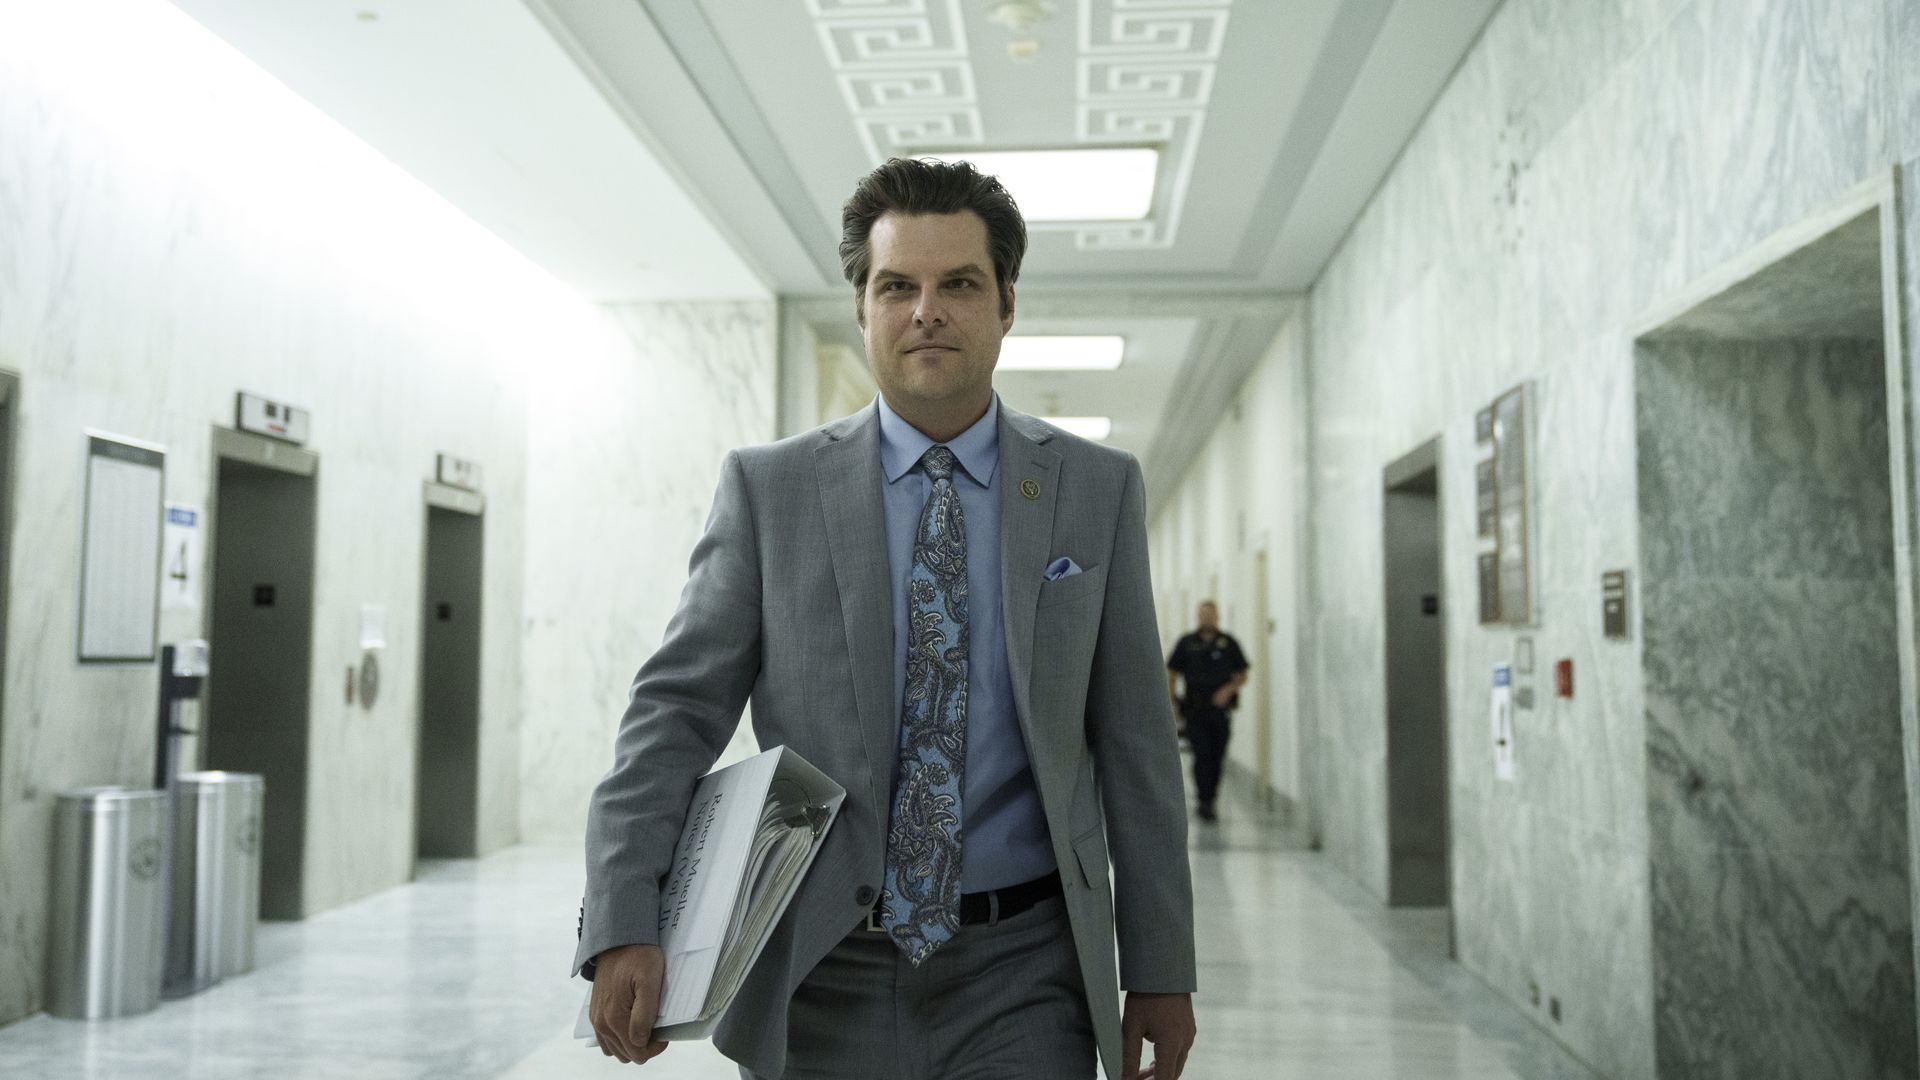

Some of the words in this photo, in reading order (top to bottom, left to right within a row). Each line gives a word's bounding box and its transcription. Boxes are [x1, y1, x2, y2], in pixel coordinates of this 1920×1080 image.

[685, 801, 709, 851] Notes
[696, 793, 723, 852] Robert
[672, 857, 701, 930] Mueller
